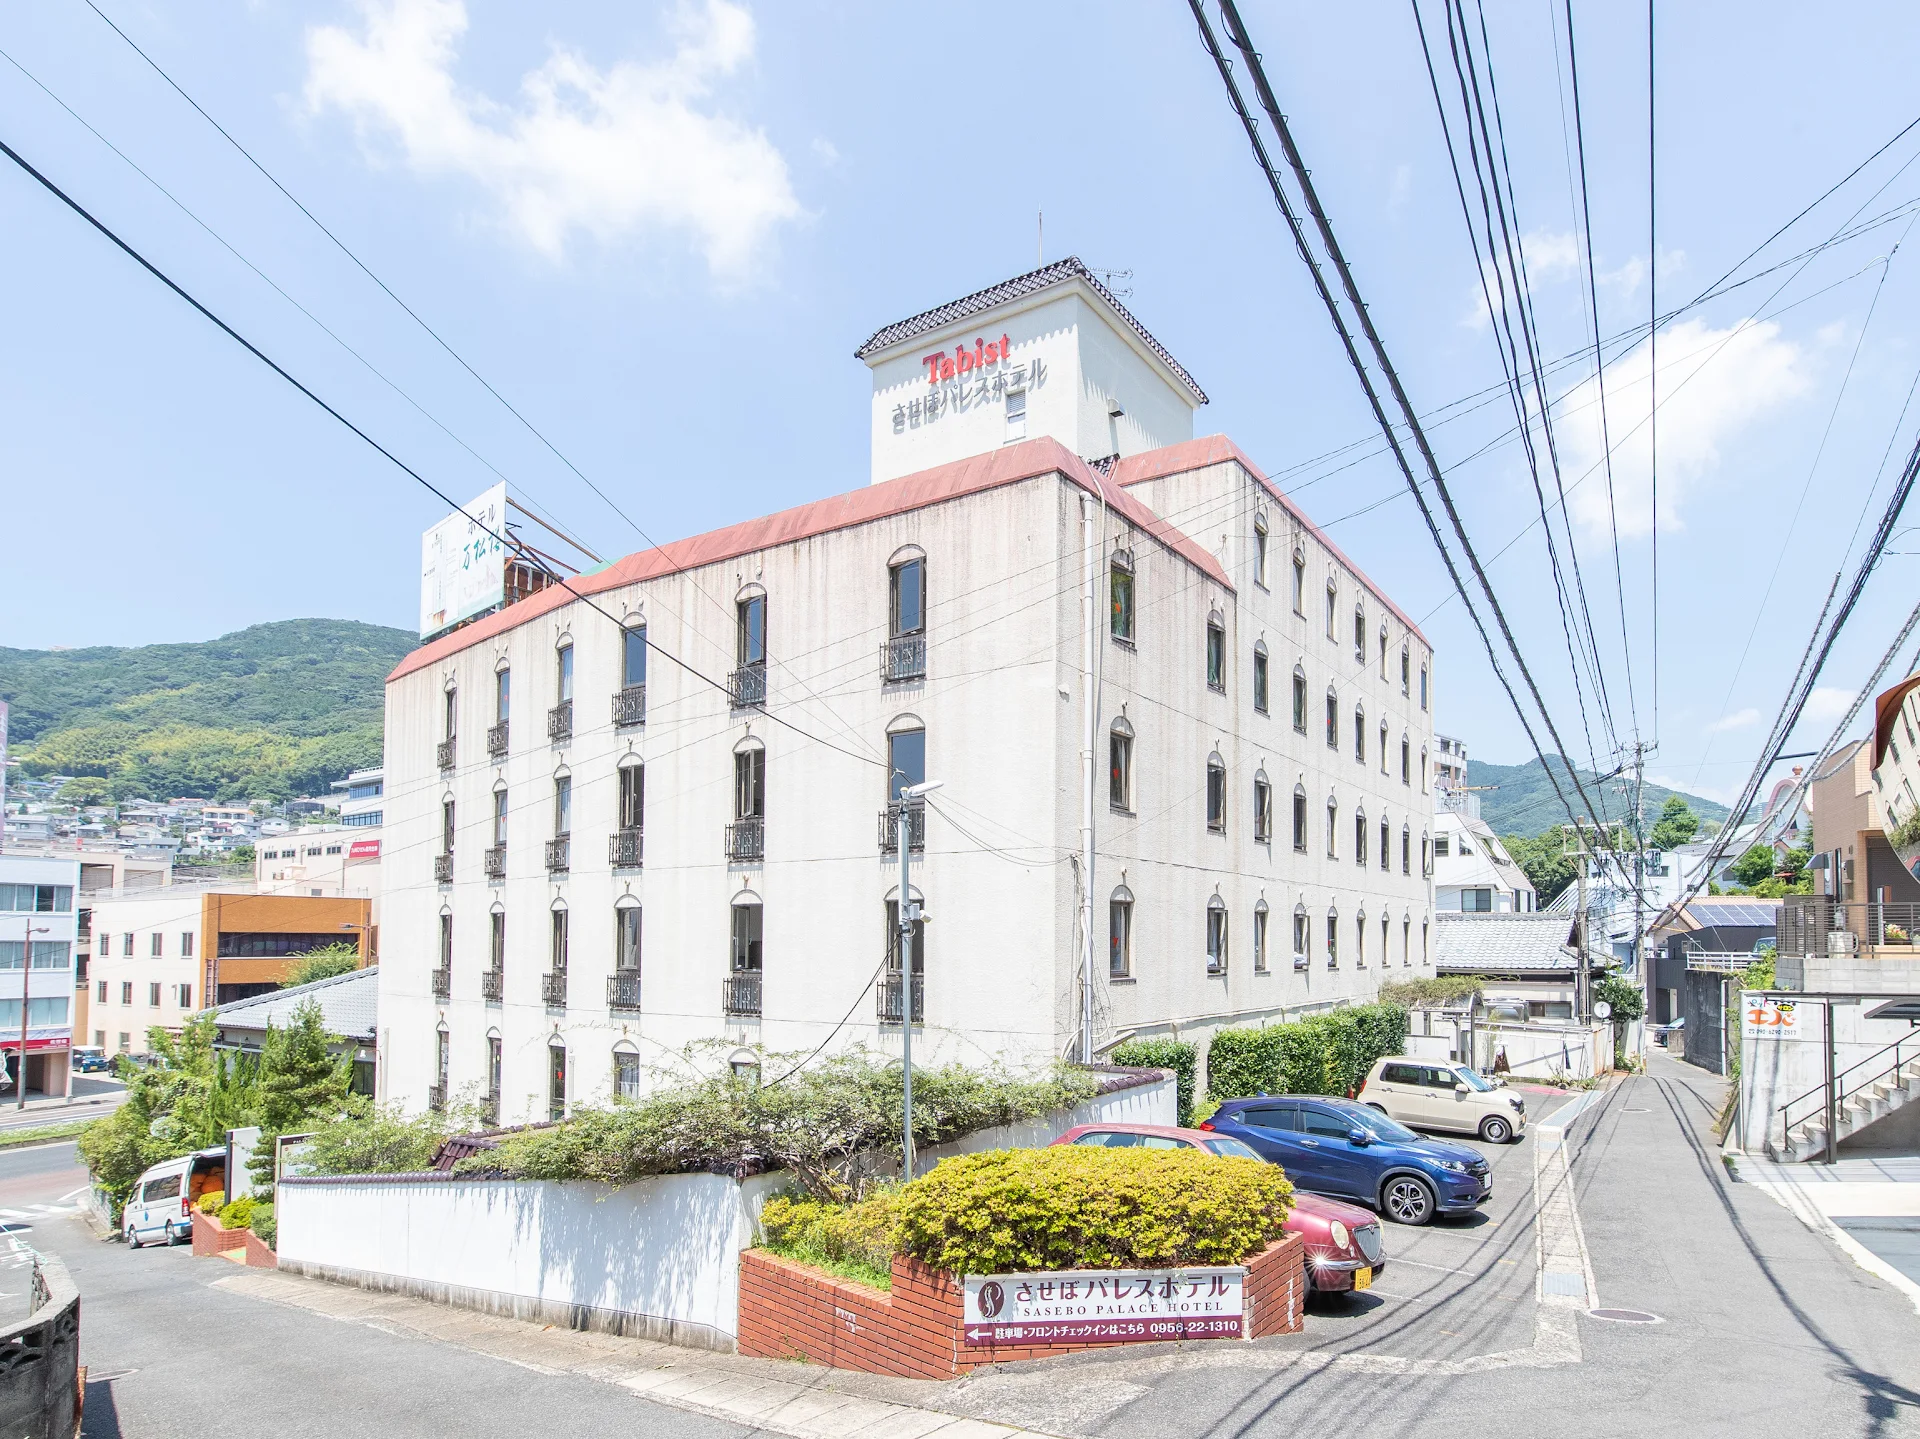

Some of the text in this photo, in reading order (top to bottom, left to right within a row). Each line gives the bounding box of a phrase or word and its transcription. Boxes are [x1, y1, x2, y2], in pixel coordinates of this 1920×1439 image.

[923, 333, 1011, 384] Tabist
[892, 358, 1048, 421] させぼパレスホテル
[468, 504, 496, 535] ホテル
[1016, 1276, 1230, 1302] させぼパレスホテル
[1023, 1302, 1223, 1317] SASEBO PALACE HOTEL
[995, 1321, 1238, 1339] 駐車場・フロントチェックインはこちら 0956-22-1310
